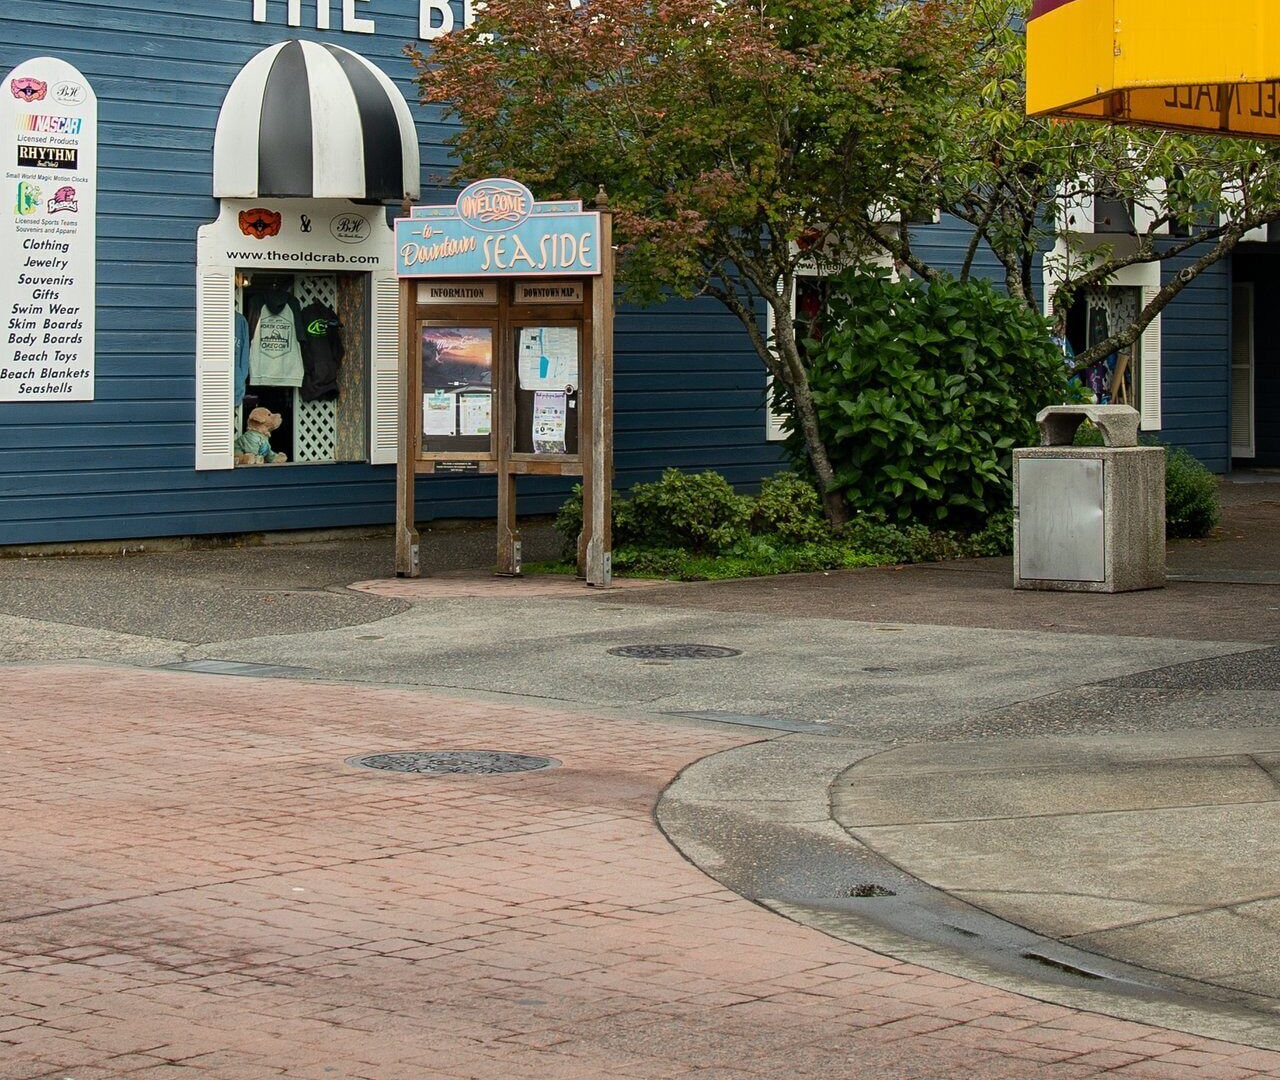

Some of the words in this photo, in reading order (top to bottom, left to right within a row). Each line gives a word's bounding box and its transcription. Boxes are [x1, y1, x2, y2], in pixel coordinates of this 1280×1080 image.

[35, 115, 81, 134] NASCAR
[17, 135, 47, 144] Licensed
[49, 136, 79, 146] Products
[19, 146, 76, 161] RHYTHM
[462, 191, 527, 219] WELCOME
[41, 218, 59, 226] Sports
[22, 239, 70, 253] Clothing
[400, 234, 477, 266] Downtown
[481, 232, 592, 270] SEASIDE
[23, 256, 68, 270] Jewelry
[226, 250, 379, 264] www.theoldcrab.com
[17, 273, 74, 285] Souvenirs
[32, 289, 59, 300] Gifts
[430, 288, 484, 298] INFORMATION
[523, 287, 560, 298] DOWNTOWN
[560, 287, 575, 297] MAP
[11, 303, 43, 314] Swim
[49, 304, 80, 314] Wear
[8, 318, 36, 329] Skim
[43, 318, 83, 329] Boards
[8, 333, 37, 346] Body
[43, 333, 83, 344] Boards
[13, 350, 48, 361] Beach
[54, 350, 77, 363] Toys
[0, 368, 35, 379] Beach
[40, 368, 90, 379] Blankets
[18, 382, 73, 394] Seashells
